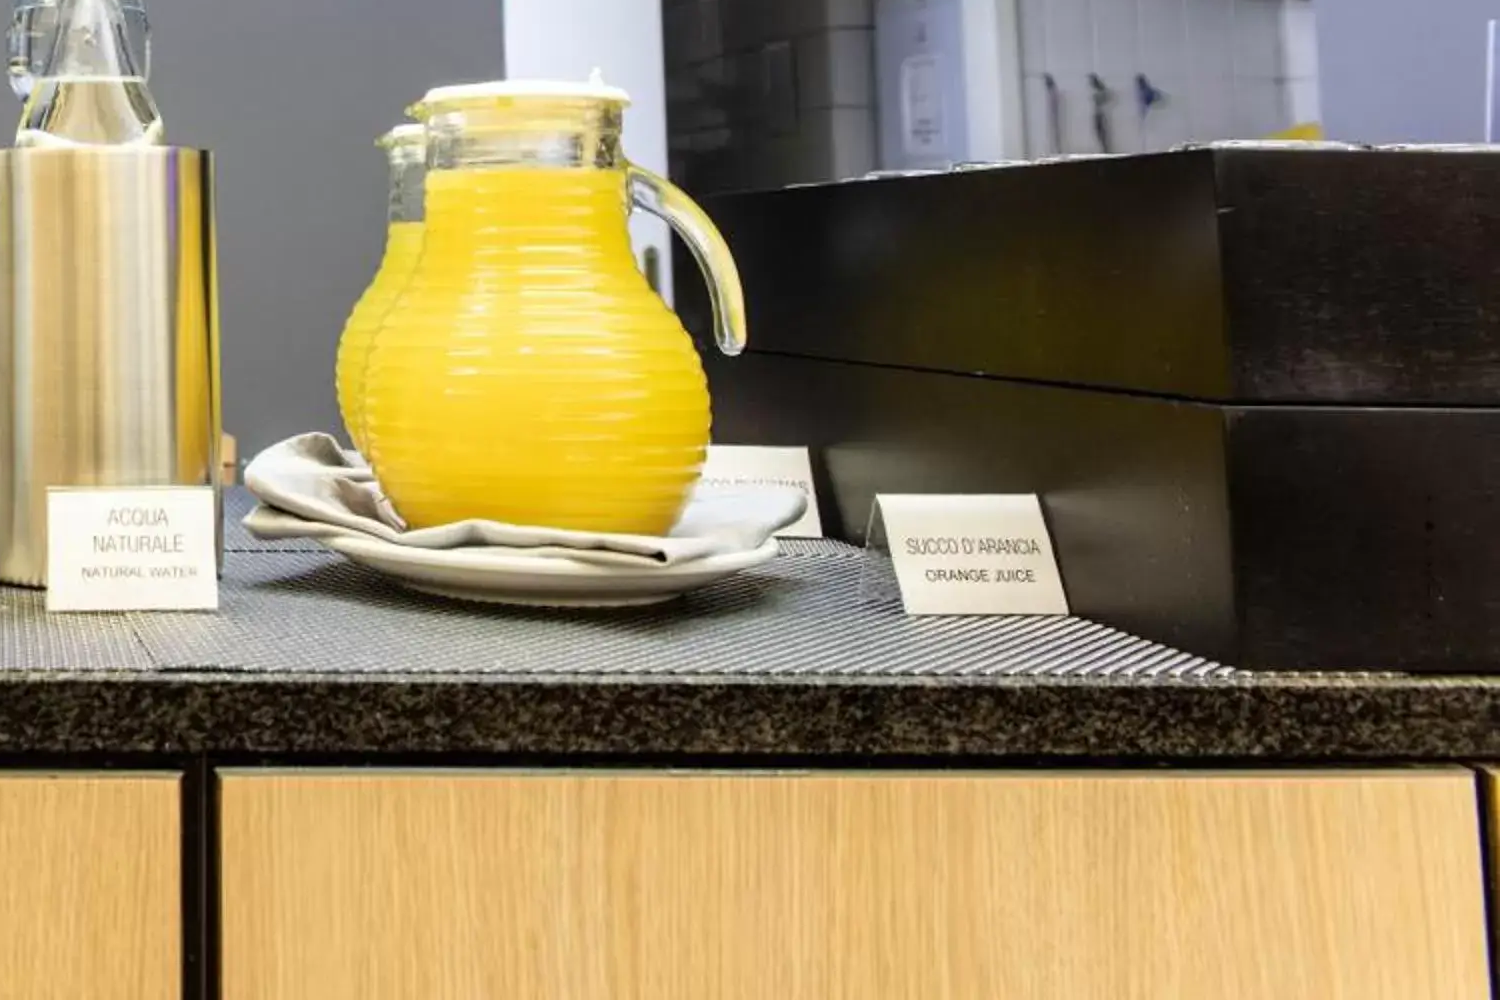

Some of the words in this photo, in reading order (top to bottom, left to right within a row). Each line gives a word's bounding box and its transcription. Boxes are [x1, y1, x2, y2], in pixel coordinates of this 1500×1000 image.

[108, 507, 170, 528] ACQUA
[93, 534, 185, 554] NATURALE
[905, 538, 959, 555] SUCCO
[81, 566, 144, 579] NATURAL
[149, 566, 198, 579] WATER
[925, 569, 990, 583] ORANGE
[996, 569, 1037, 583] JUICE
